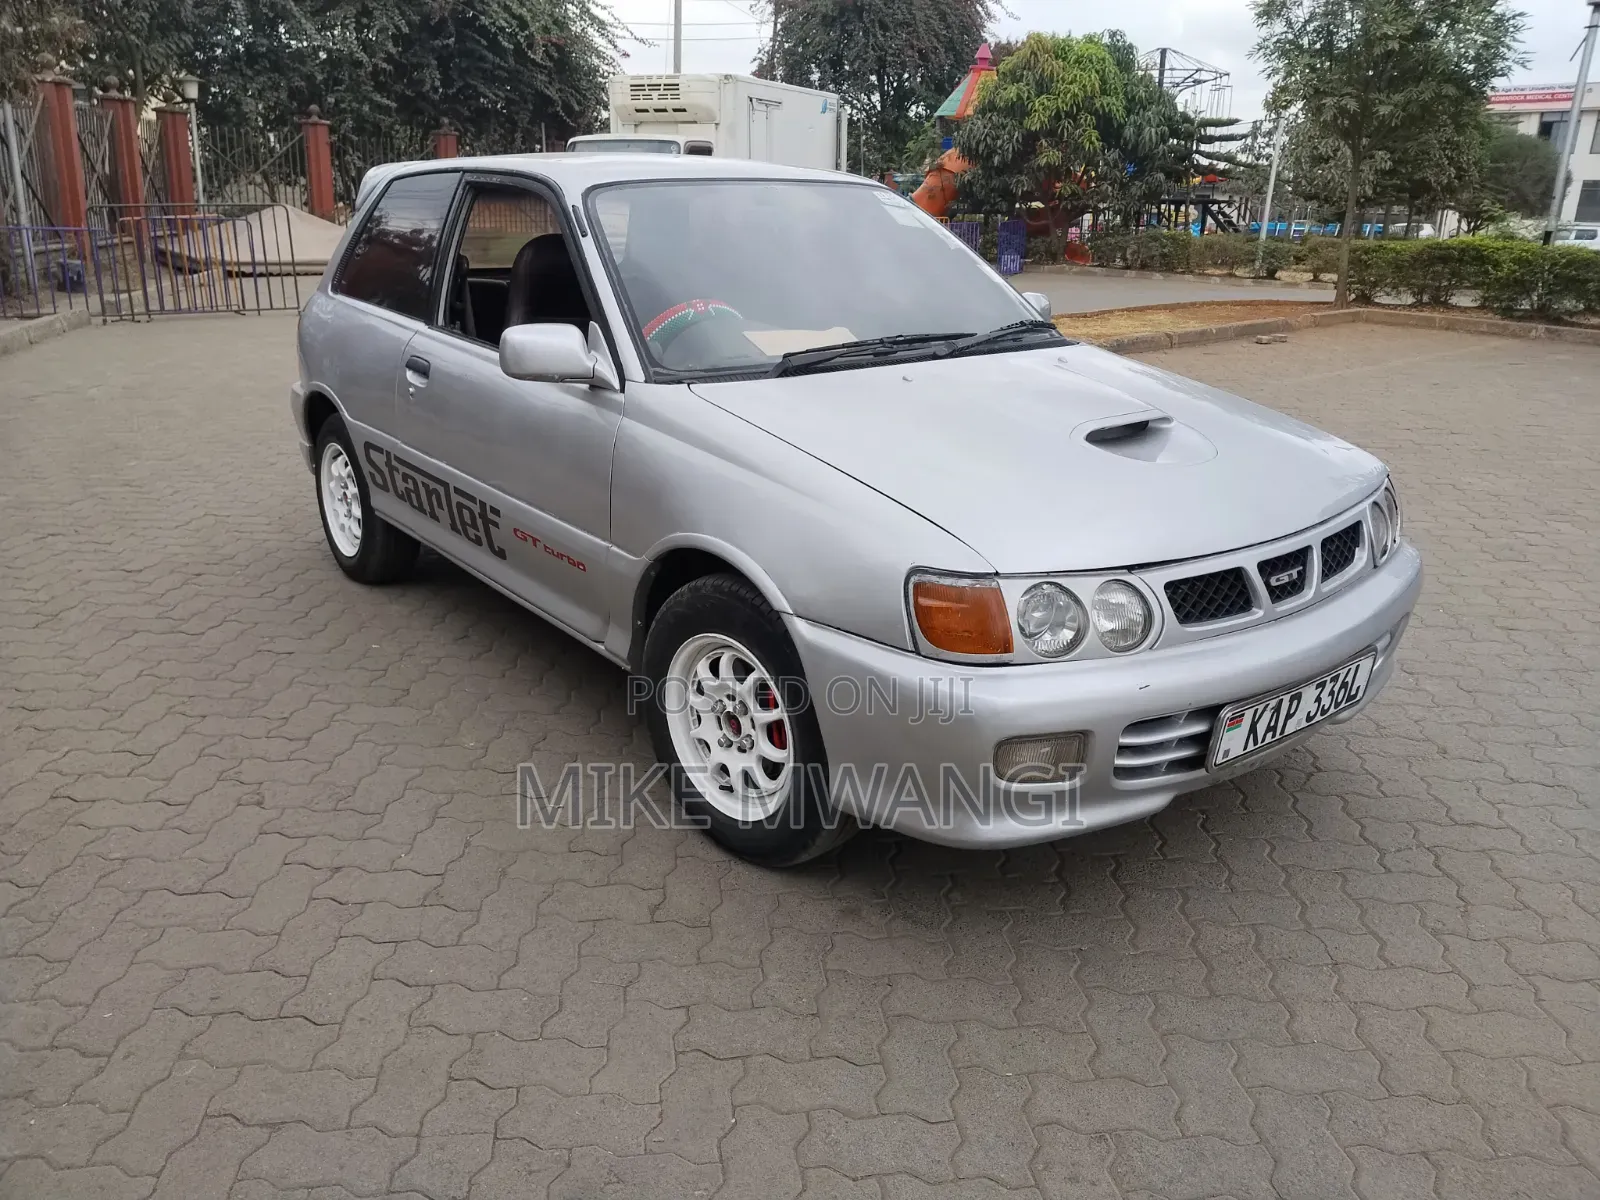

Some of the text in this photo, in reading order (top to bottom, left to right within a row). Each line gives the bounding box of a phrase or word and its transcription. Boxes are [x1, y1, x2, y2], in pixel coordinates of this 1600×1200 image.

[363, 440, 587, 572] Starlet GT turbo
[1269, 565, 1303, 587] GT
[1243, 663, 1361, 751] KAP 336L
